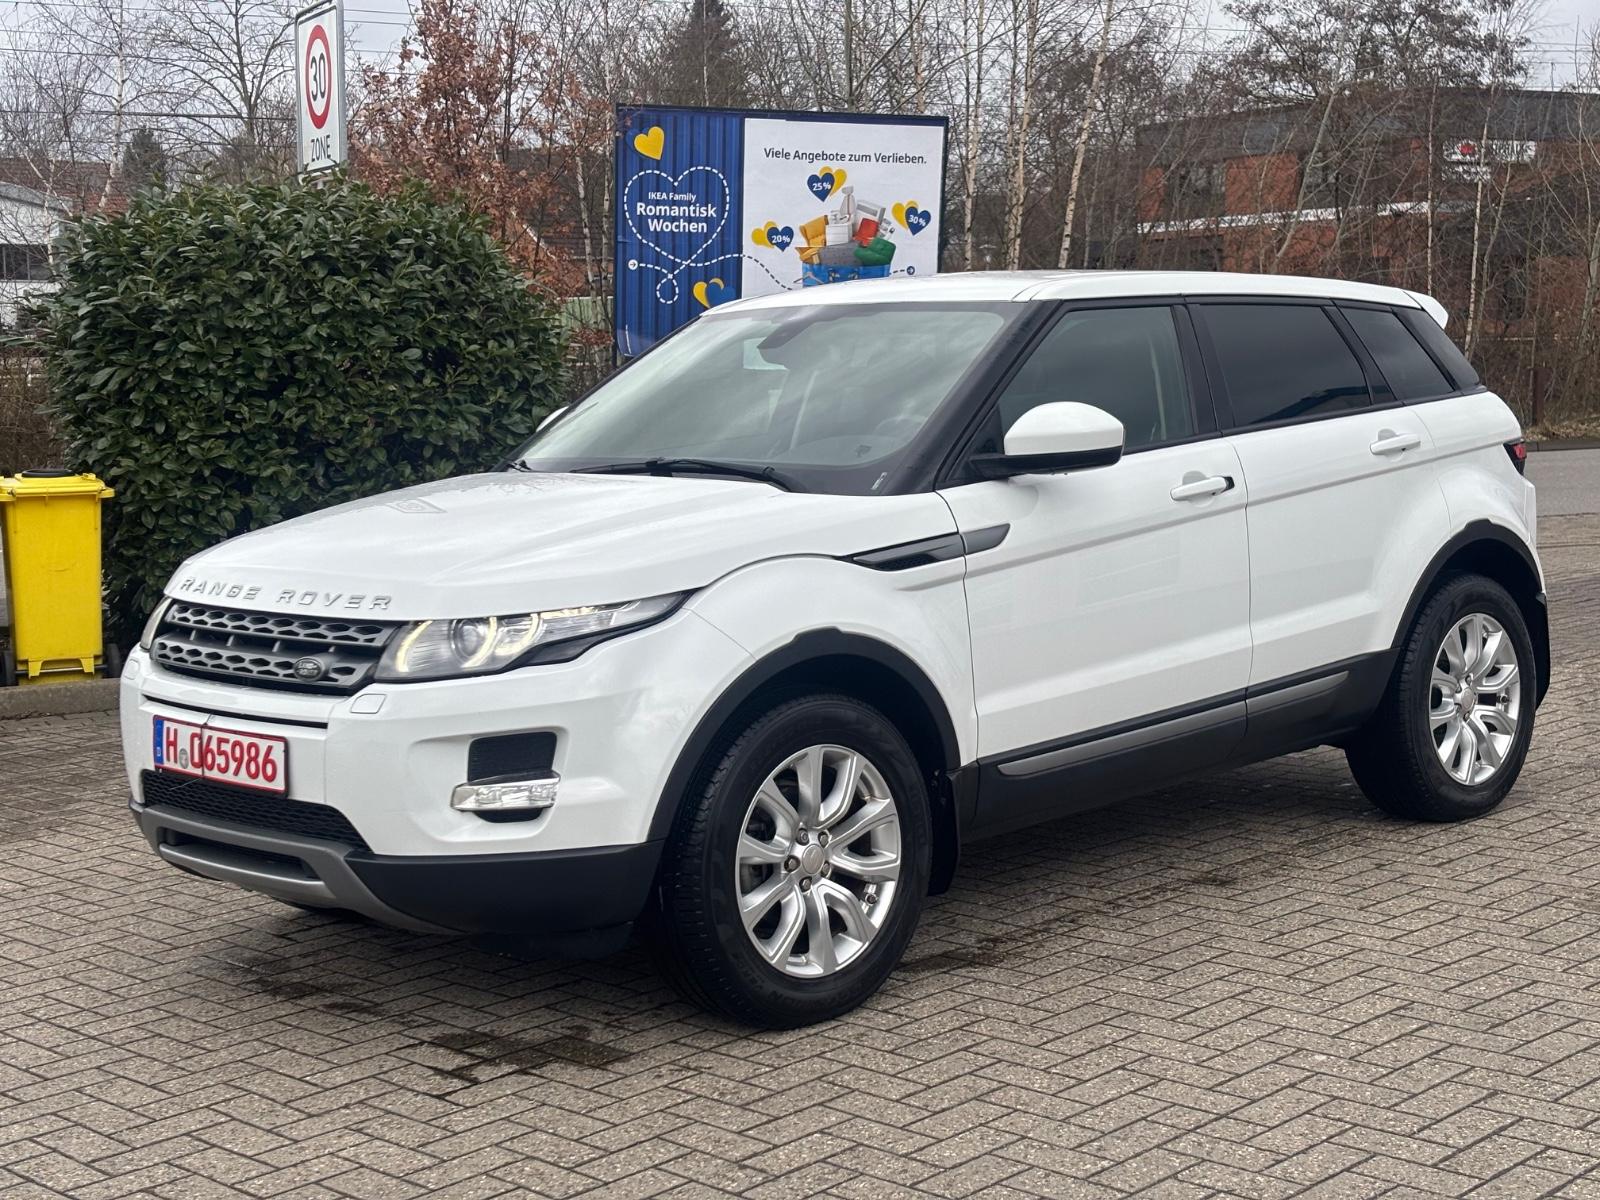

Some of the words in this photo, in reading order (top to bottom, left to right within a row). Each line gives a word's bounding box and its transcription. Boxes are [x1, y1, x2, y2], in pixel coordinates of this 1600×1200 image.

[310, 52, 326, 101] 30
[311, 135, 331, 162] ZONE
[764, 148, 791, 160] Viele
[793, 150, 846, 164] Angebote
[848, 153, 872, 163] zum
[874, 152, 927, 164] Verlieben.
[812, 182, 832, 191] 25%
[648, 192, 668, 200] IKEA
[669, 192, 697, 203] Family
[636, 202, 717, 217] Romantisk
[648, 218, 707, 233] Wochen
[908, 214, 926, 227] 30%
[771, 235, 791, 244] 20%
[180, 578, 261, 600] RANGE
[277, 590, 391, 610] ROVER
[166, 726, 178, 764] H
[189, 731, 278, 783] 065986
